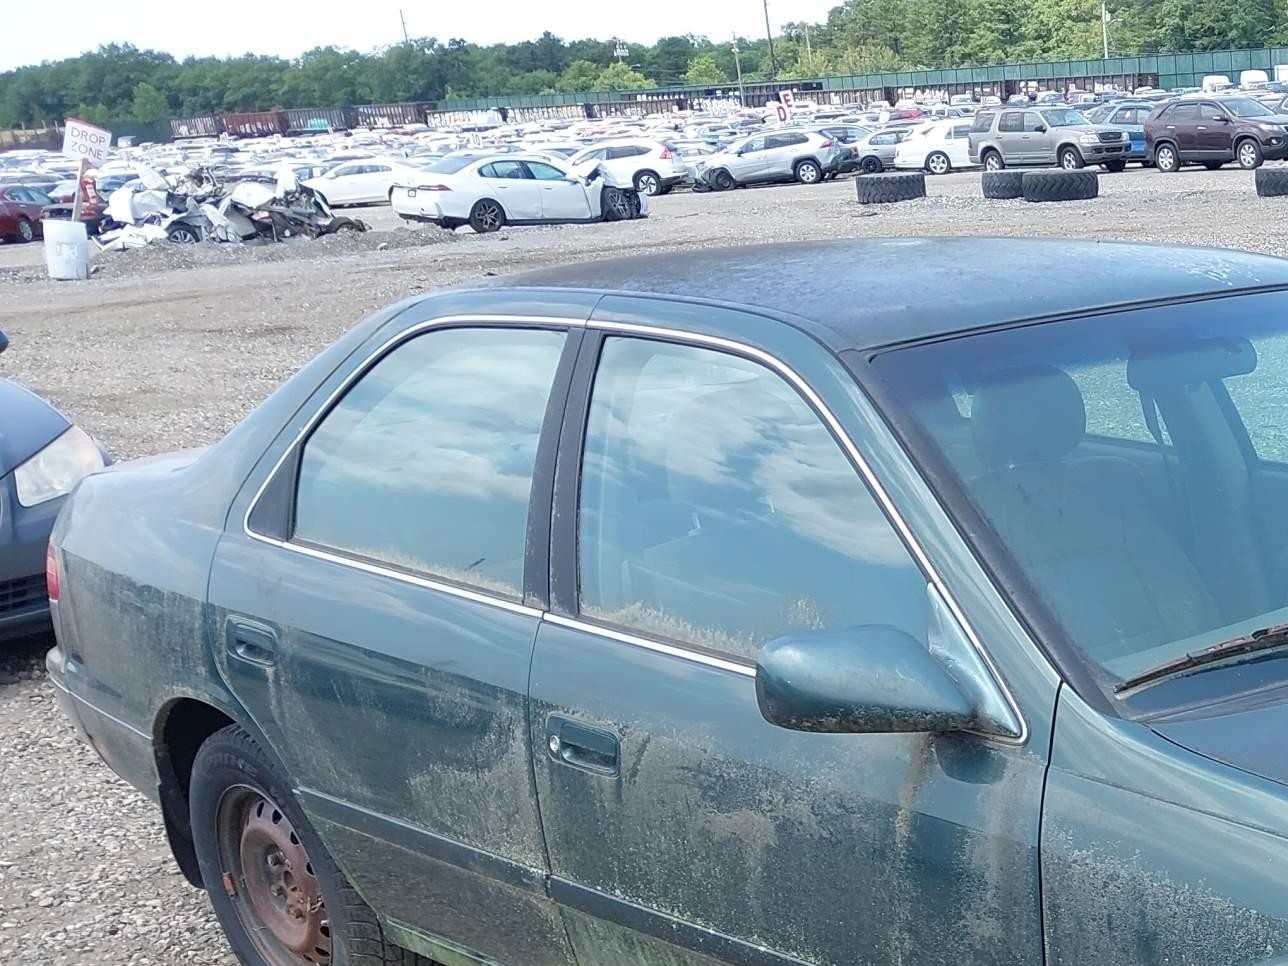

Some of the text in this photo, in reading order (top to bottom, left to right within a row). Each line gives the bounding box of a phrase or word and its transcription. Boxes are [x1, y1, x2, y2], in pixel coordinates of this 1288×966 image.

[783, 93, 793, 108] E
[777, 105, 787, 122] D
[70, 126, 106, 146] DROP
[71, 142, 104, 161] ZONE
